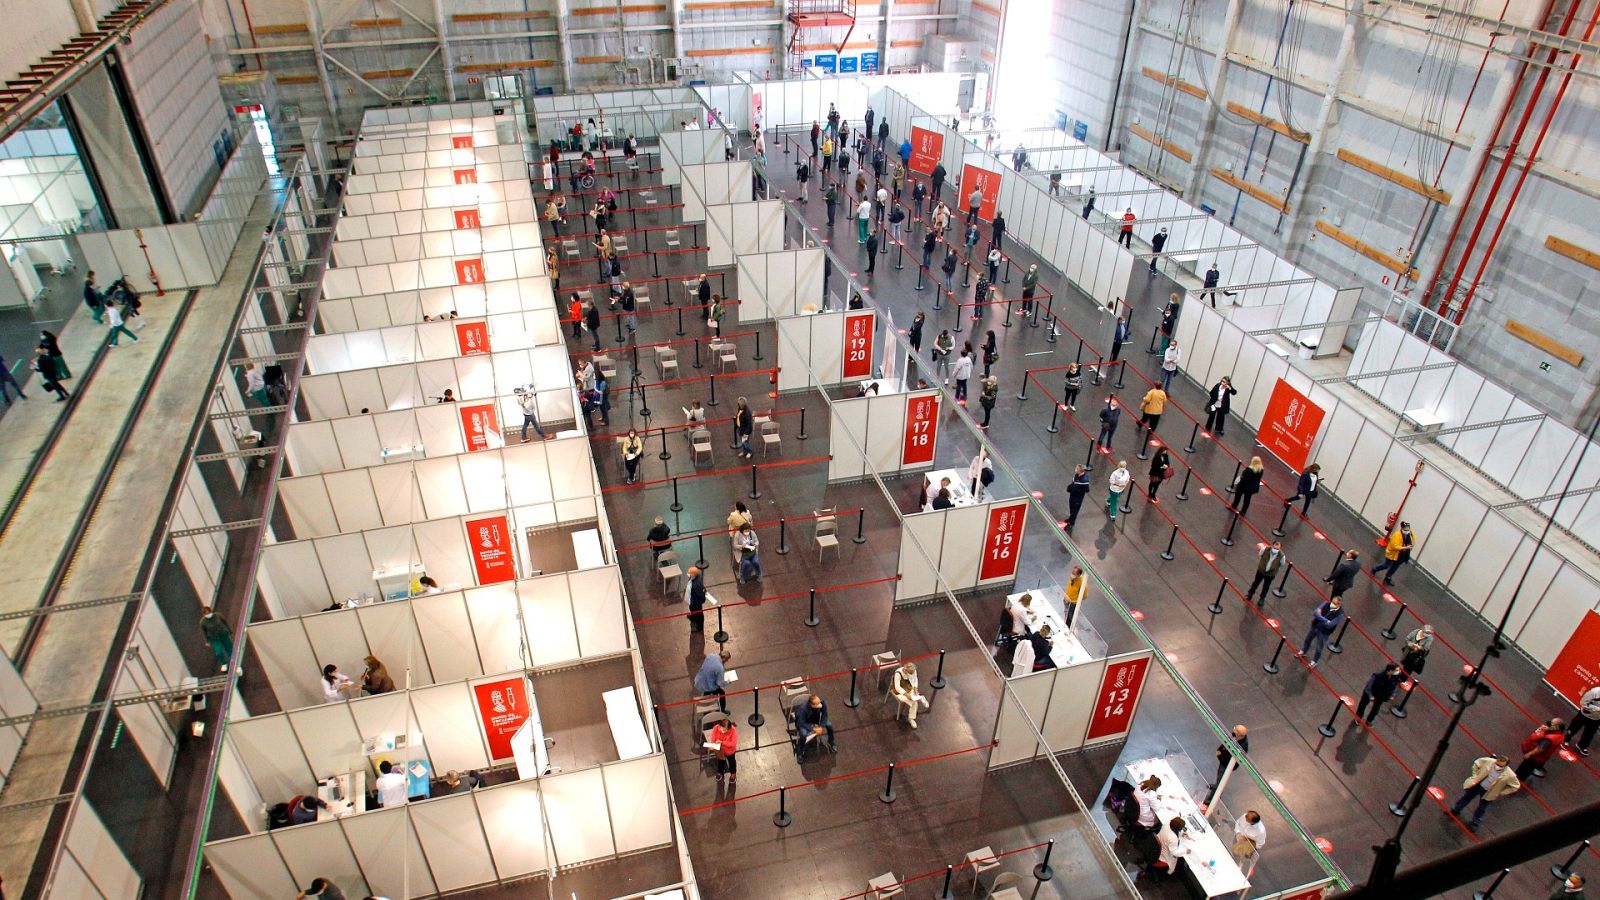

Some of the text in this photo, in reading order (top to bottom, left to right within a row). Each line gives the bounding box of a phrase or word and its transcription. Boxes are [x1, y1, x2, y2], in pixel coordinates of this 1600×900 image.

[851, 338, 865, 349] 19
[850, 350, 865, 361] 20
[913, 420, 930, 433] 17
[912, 434, 928, 446] 18
[995, 532, 1013, 546] 15
[992, 546, 1010, 560] 16
[1109, 688, 1130, 703] 13
[1104, 703, 1124, 718] 14
